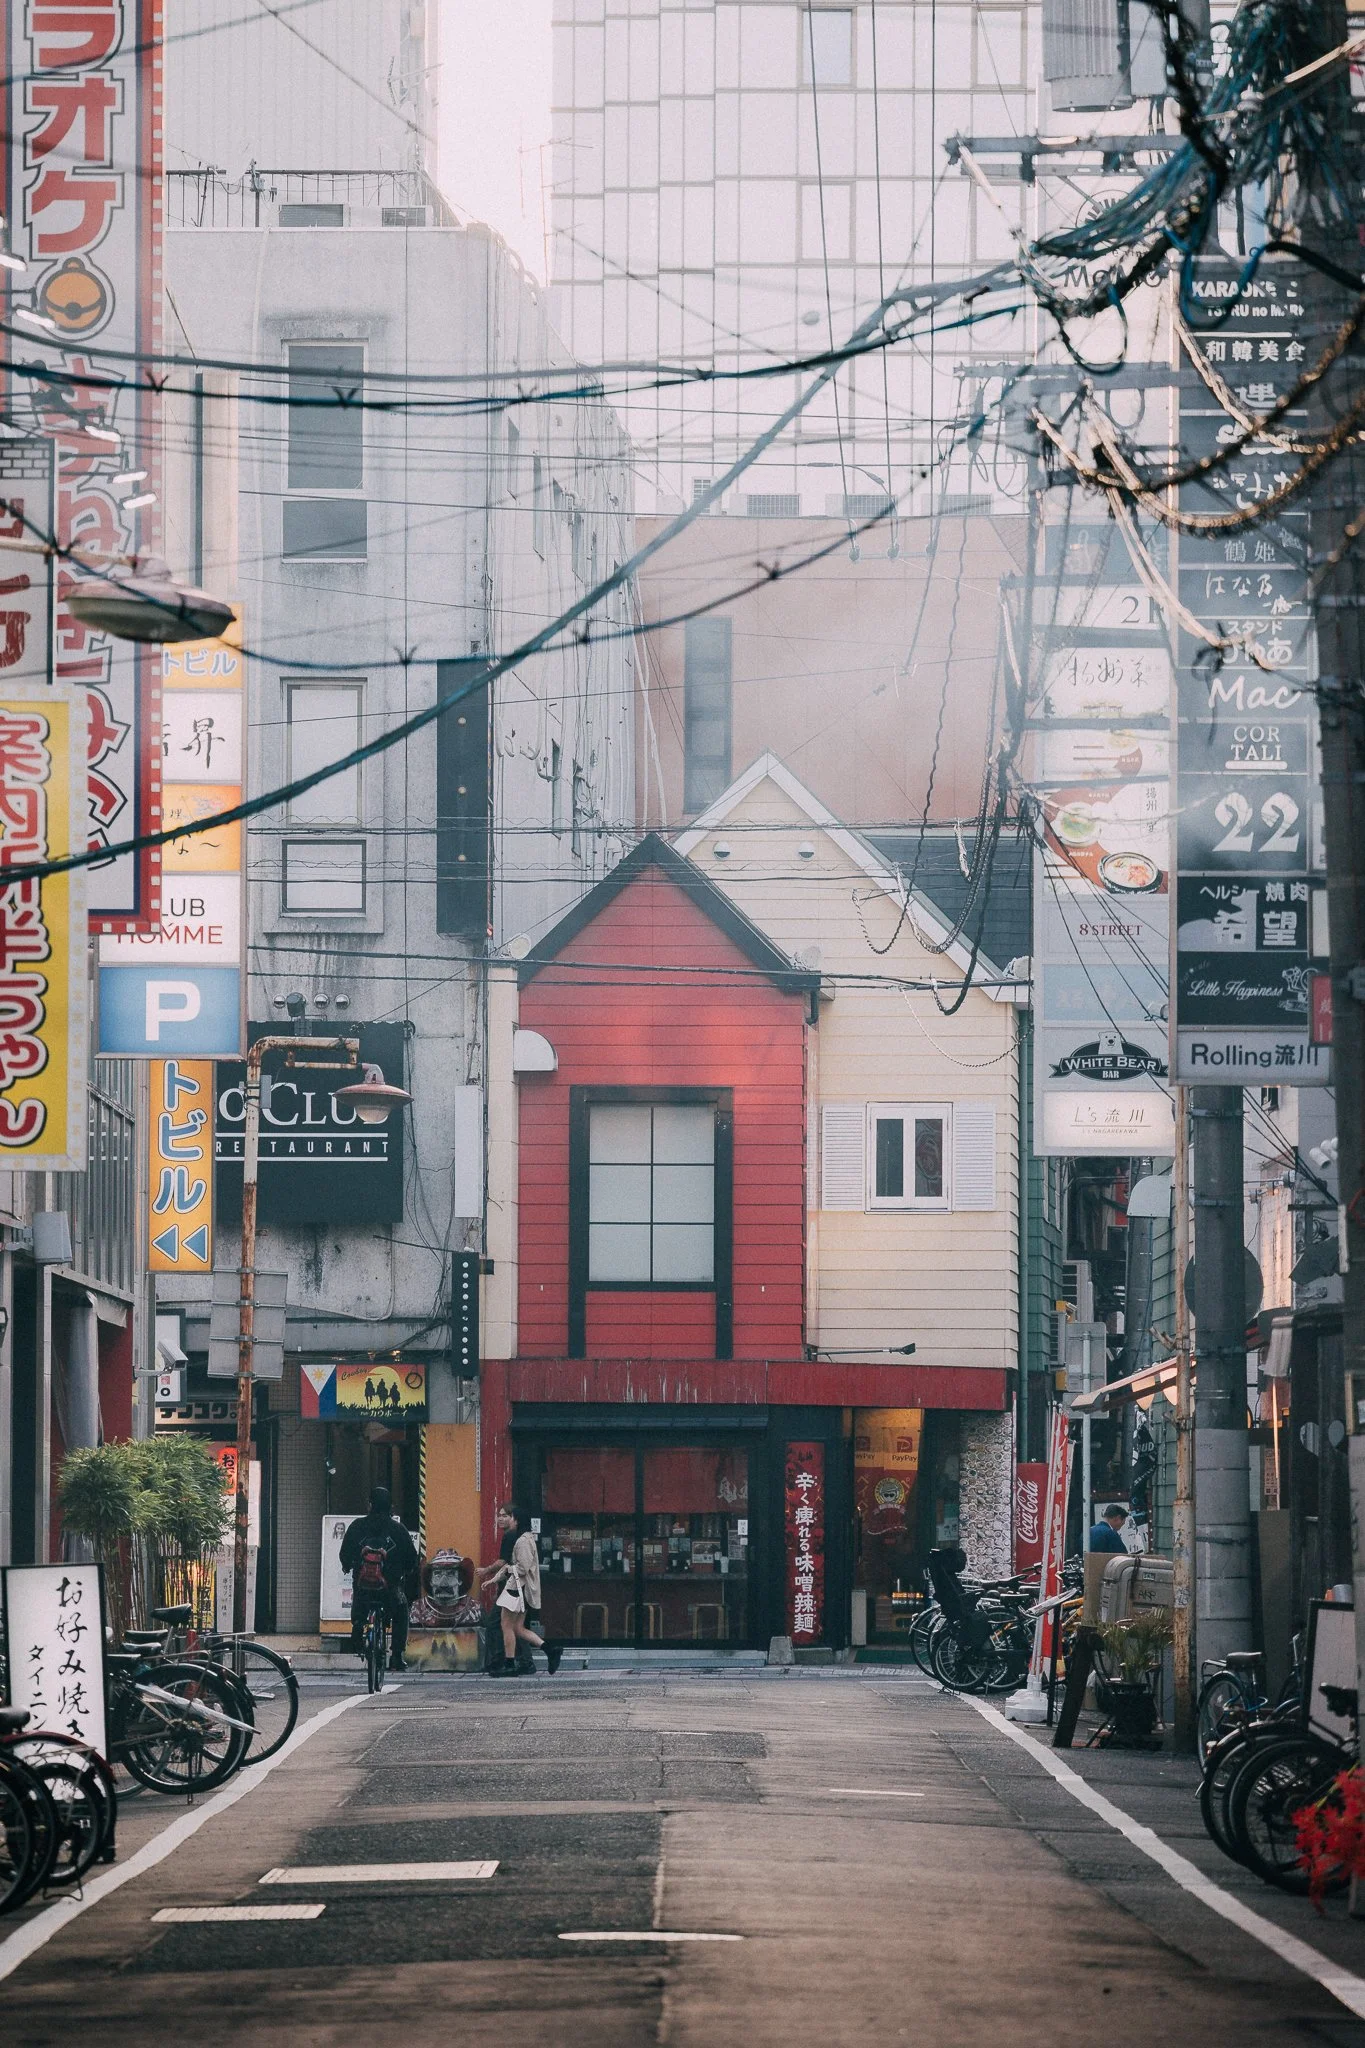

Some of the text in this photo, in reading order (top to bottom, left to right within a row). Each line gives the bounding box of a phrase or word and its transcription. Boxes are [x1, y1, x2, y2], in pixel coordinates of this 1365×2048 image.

[1206, 340, 1306, 362] 和韓美食
[1208, 675, 1302, 712] Mac
[1233, 726, 1281, 743] COR
[1231, 744, 1282, 761] TALI
[1212, 792, 1300, 852] 22
[1265, 882, 1309, 902] 焼肉
[1079, 923, 1143, 936] 8 STREET
[1187, 979, 1283, 1001] Little Happiness
[145, 980, 201, 1040] P
[1064, 1056, 1157, 1071] WHITE BEAR
[1102, 1070, 1120, 1079] BAR
[151, 1059, 208, 1214] トビル
[216, 1141, 388, 1154] RETAURANT
[892, 1454, 917, 1462] PayPay
